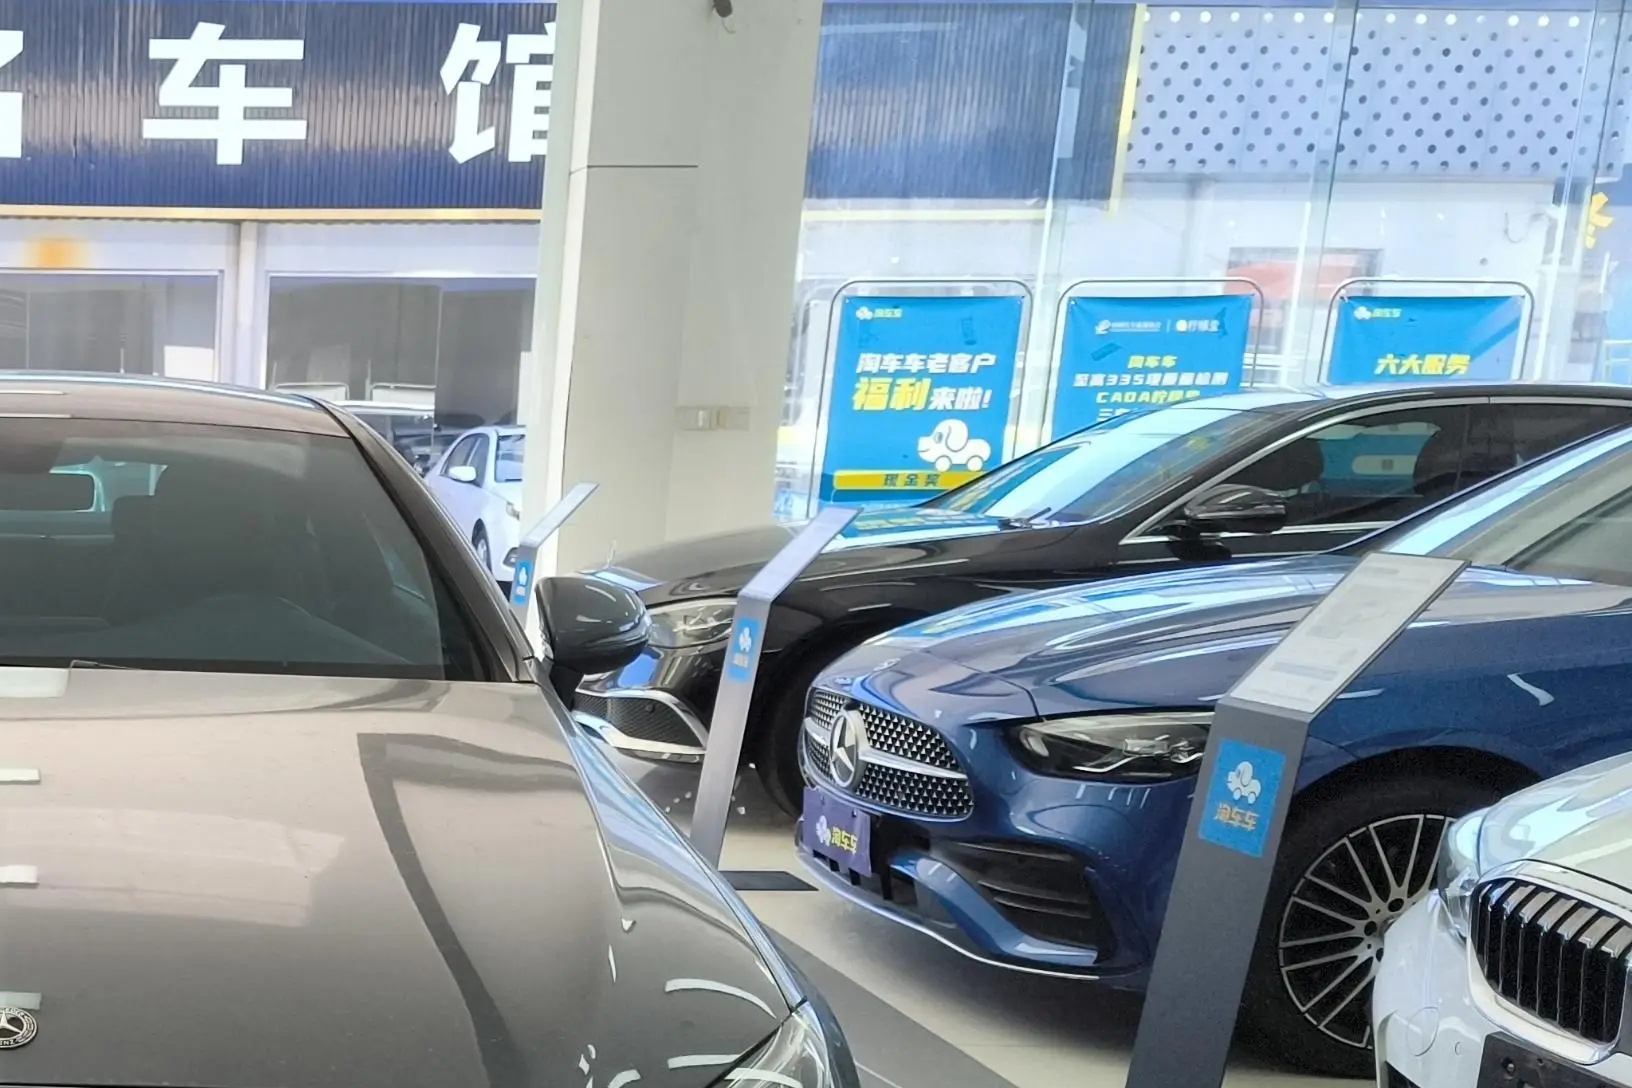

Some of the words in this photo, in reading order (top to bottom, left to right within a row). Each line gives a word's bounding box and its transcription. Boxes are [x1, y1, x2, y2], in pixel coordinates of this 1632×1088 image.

[855, 352, 997, 374] 淘车车老客户
[1373, 353, 1471, 375] 六大服务
